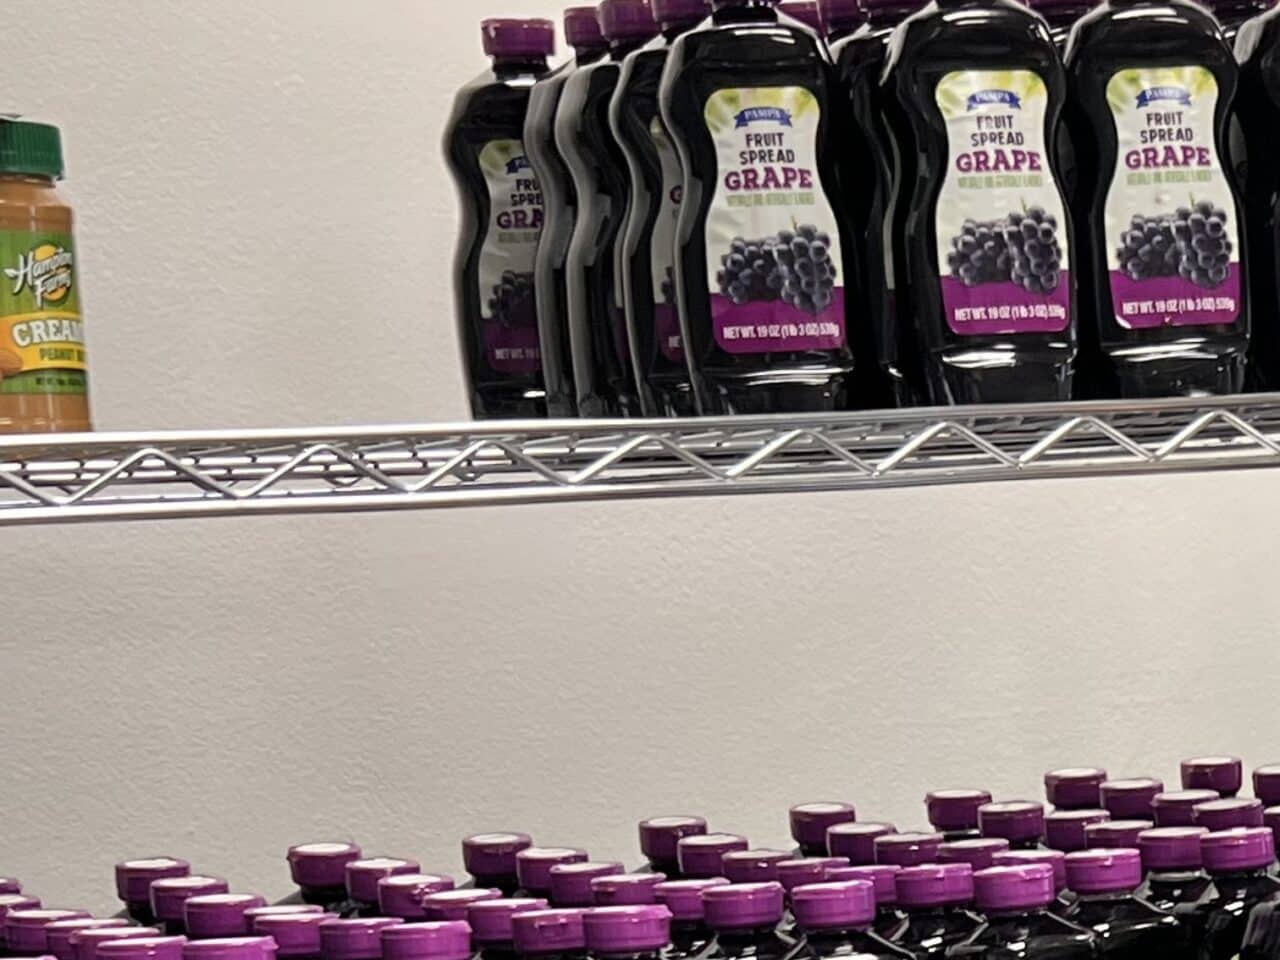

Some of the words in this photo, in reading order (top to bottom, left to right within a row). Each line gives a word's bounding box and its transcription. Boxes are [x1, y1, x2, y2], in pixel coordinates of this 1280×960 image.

[977, 115, 1014, 130] FRUIT
[1146, 112, 1184, 127] FRUIT
[746, 133, 784, 147] FRUIT
[971, 132, 1024, 147] SPREAD
[1140, 128, 1193, 144] SPREAD
[740, 149, 795, 165] SPREAD
[956, 150, 1041, 173] GRAPE
[1125, 146, 1211, 169] GRAPE
[517, 179, 540, 192] FRU
[725, 167, 813, 191] GRAPE
